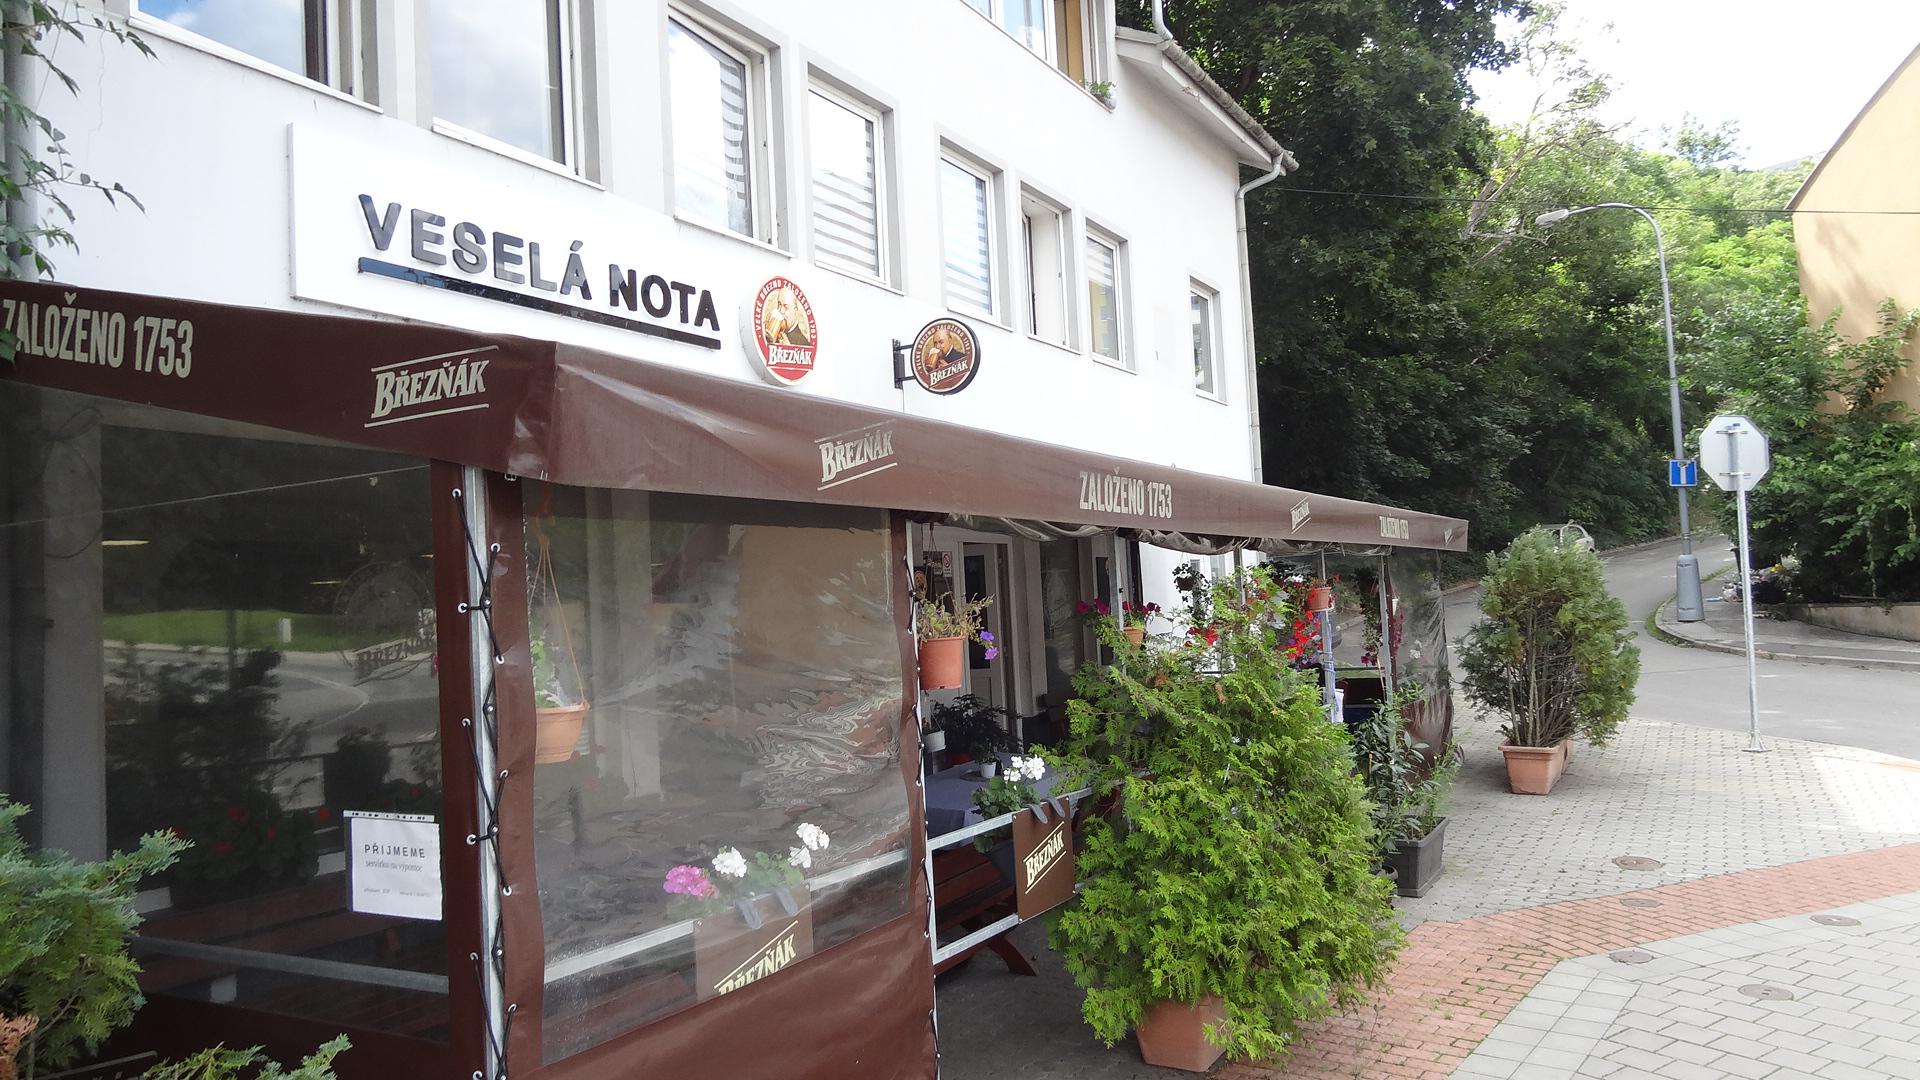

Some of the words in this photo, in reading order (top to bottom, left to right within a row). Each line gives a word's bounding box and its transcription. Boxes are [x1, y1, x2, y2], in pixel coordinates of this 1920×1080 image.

[358, 193, 592, 300] VESELÁ
[608, 263, 720, 331] NOTA
[3, 291, 126, 368] ZALOŽENO
[134, 315, 194, 379] 1753
[768, 345, 812, 366] BŘEZŇÁK
[371, 358, 490, 419] BŘEZŇÁK
[819, 429, 894, 483] BŘEZŇÁK
[1079, 466, 1144, 515] ZALOŽENO
[1147, 481, 1172, 519] 1753
[1025, 830, 1064, 888] BŘEZŇÁK
